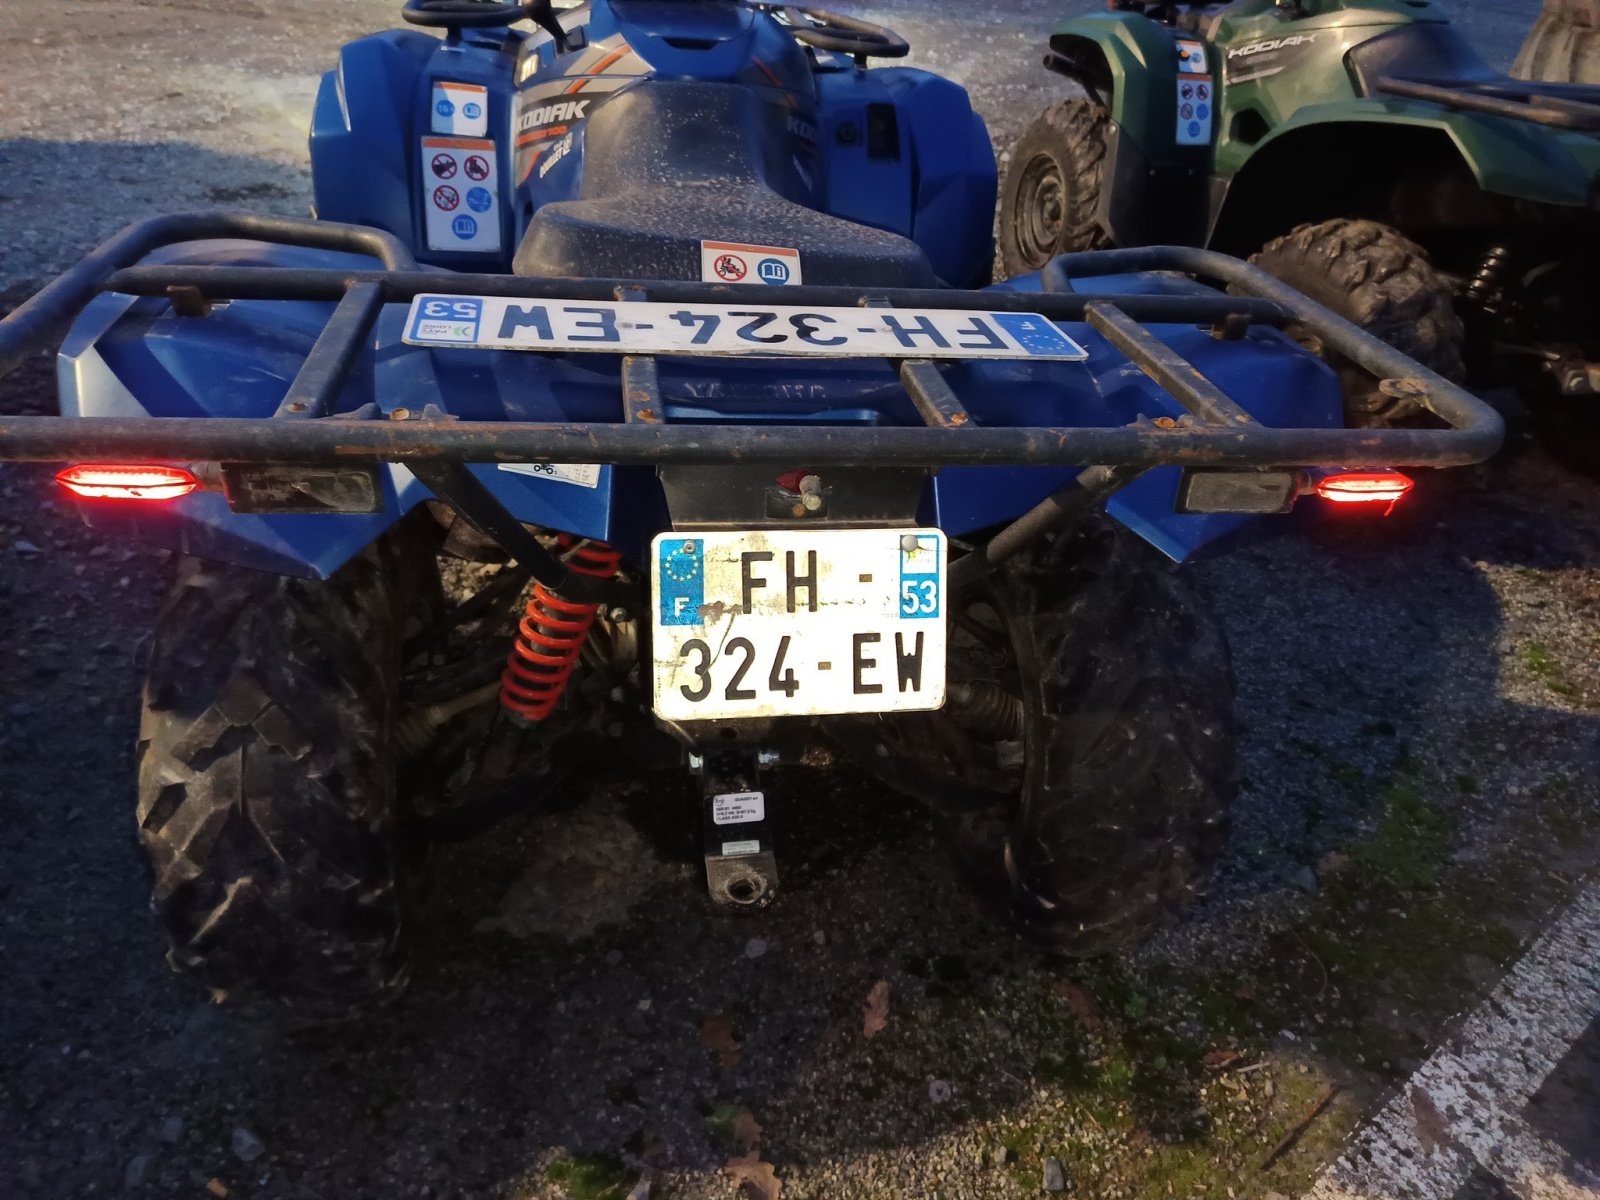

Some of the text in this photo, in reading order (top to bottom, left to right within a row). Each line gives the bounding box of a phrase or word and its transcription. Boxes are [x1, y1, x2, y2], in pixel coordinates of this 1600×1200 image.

[1227, 33, 1318, 59] KODIAK
[516, 99, 591, 133] KODIAK
[424, 301, 478, 319] 53
[1020, 320, 1036, 331] F
[674, 597, 690, 617] F
[902, 580, 938, 614] 53
